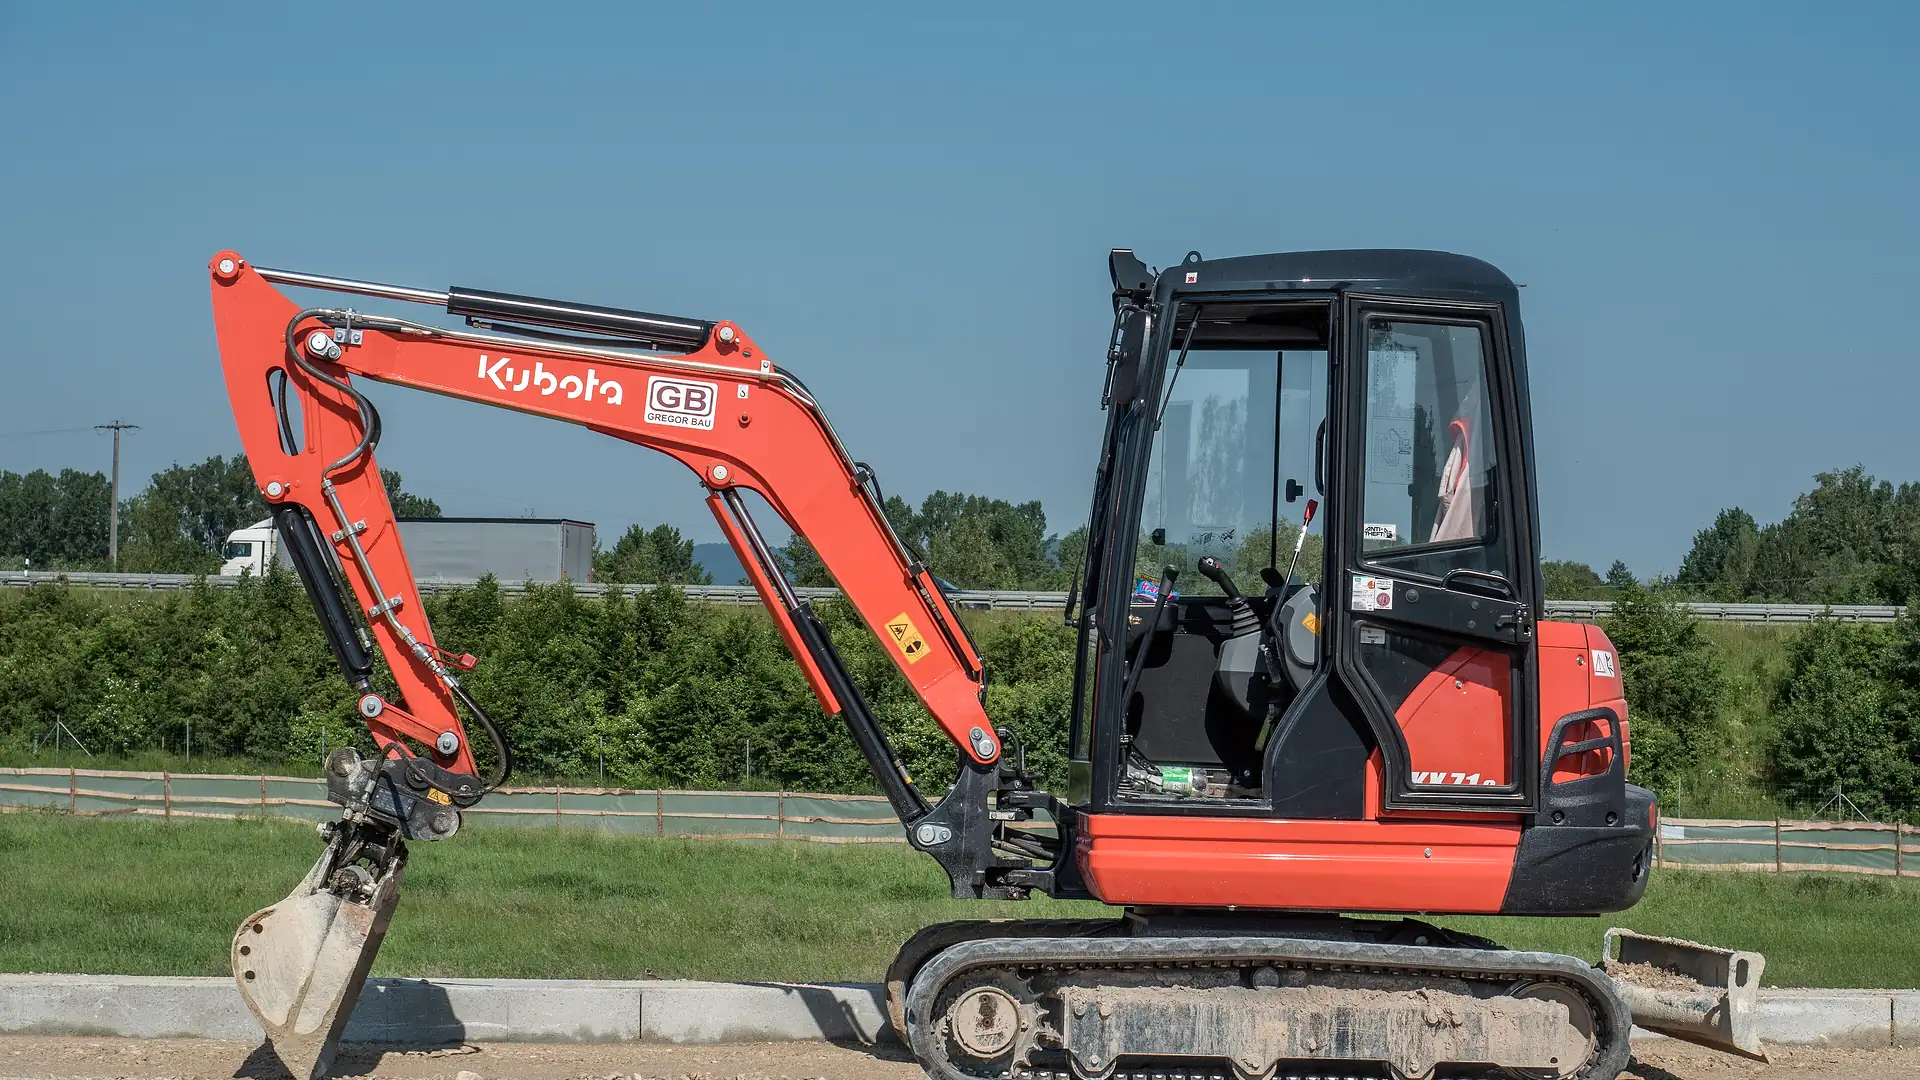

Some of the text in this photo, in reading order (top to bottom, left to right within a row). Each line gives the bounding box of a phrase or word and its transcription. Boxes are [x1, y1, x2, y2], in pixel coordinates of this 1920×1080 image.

[477, 354, 623, 406] Kubota
[656, 385, 707, 412] GB
[647, 412, 711, 428] GREGOR BAU
